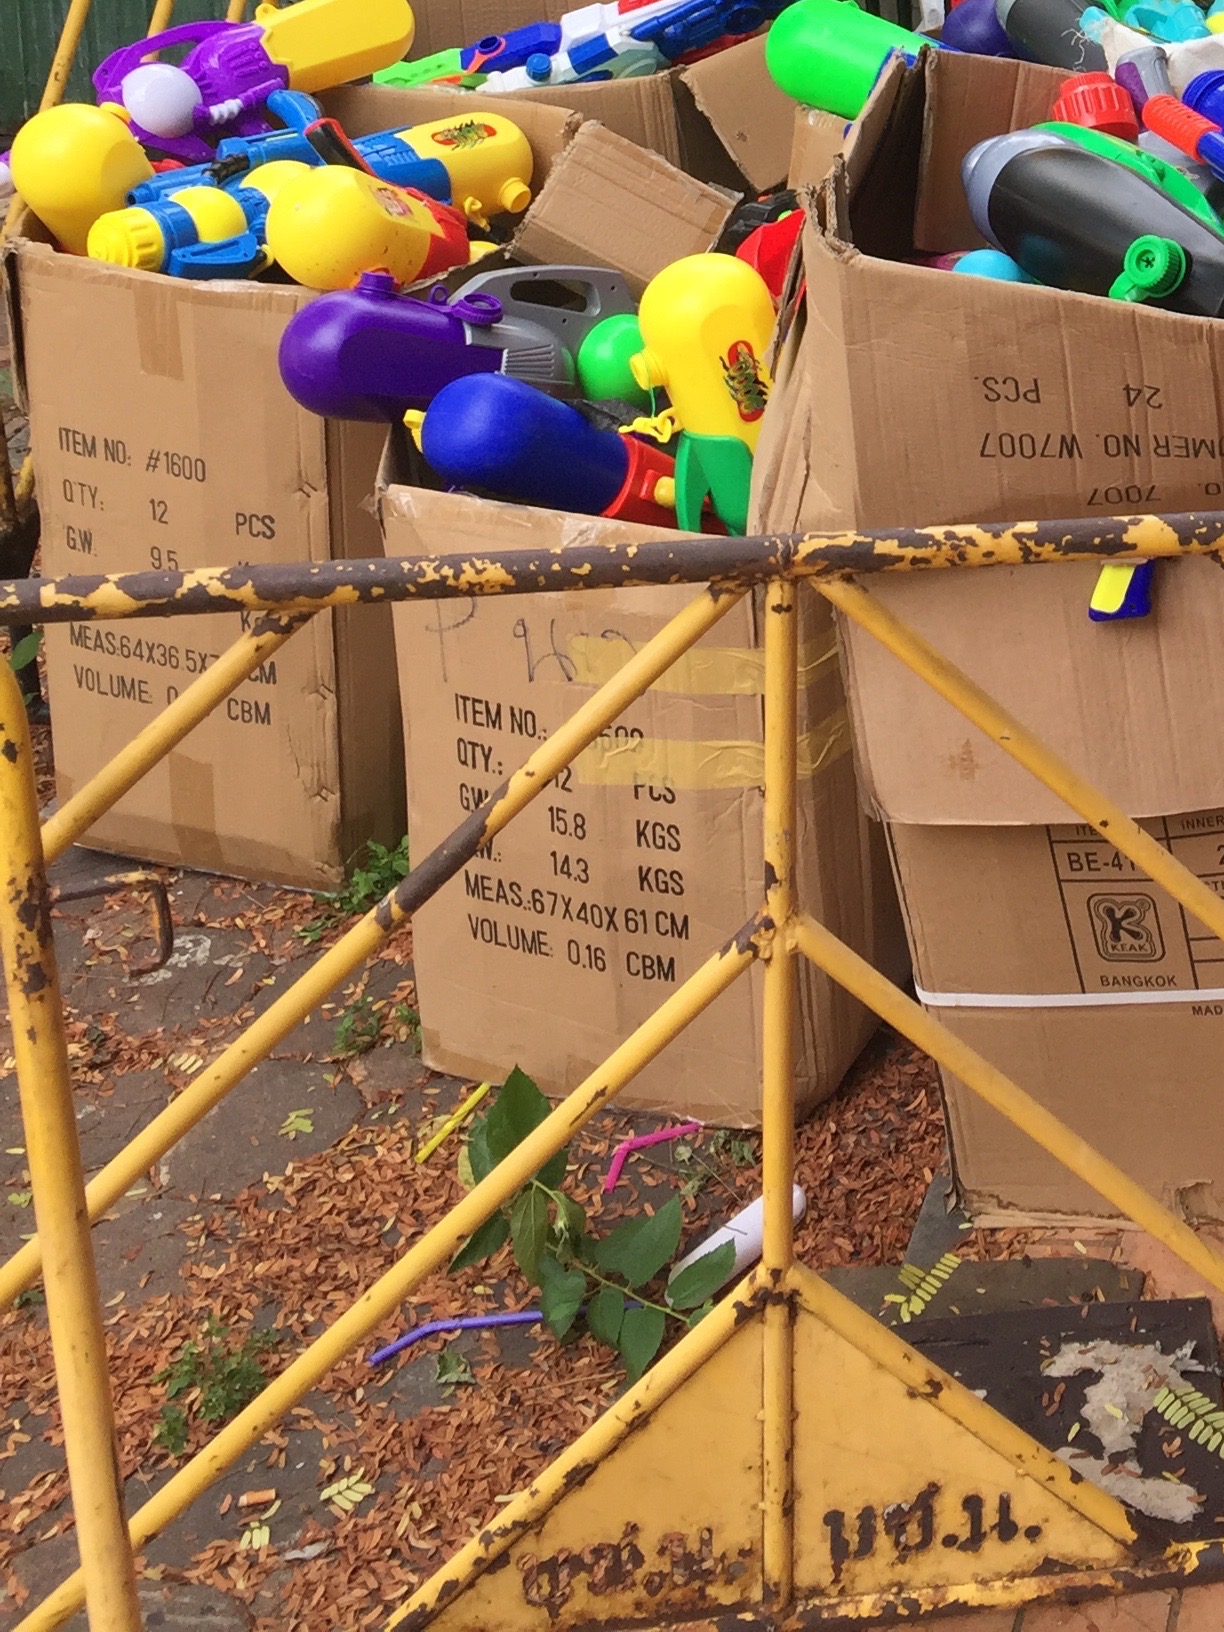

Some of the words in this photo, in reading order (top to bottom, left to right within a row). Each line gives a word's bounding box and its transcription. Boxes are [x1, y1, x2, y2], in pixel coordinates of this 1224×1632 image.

[974, 375, 1042, 404] PCS.
[1122, 383, 1163, 409] 24
[58, 427, 97, 458] ITEM
[146, 449, 206, 482] #1600
[979, 431, 1083, 460] W7007
[1095, 432, 1141, 458] NO.
[1087, 483, 1161, 506] 7007
[149, 498, 169, 525] 12
[235, 512, 276, 540] PCS
[227, 697, 272, 726] CBM
[455, 693, 502, 730] ITEM
[632, 770, 676, 804] PCS
[548, 805, 587, 841] 15.8
[636, 819, 681, 852] KGS
[1075, 825, 1100, 837] ITE
[1181, 814, 1224, 831] INNER
[550, 850, 590, 884] 14.3
[638, 865, 684, 896] KGS
[655, 910, 690, 940] CM
[567, 939, 607, 972] 0.16
[626, 951, 675, 982] CBM
[1099, 975, 1178, 987] BANGKOK
